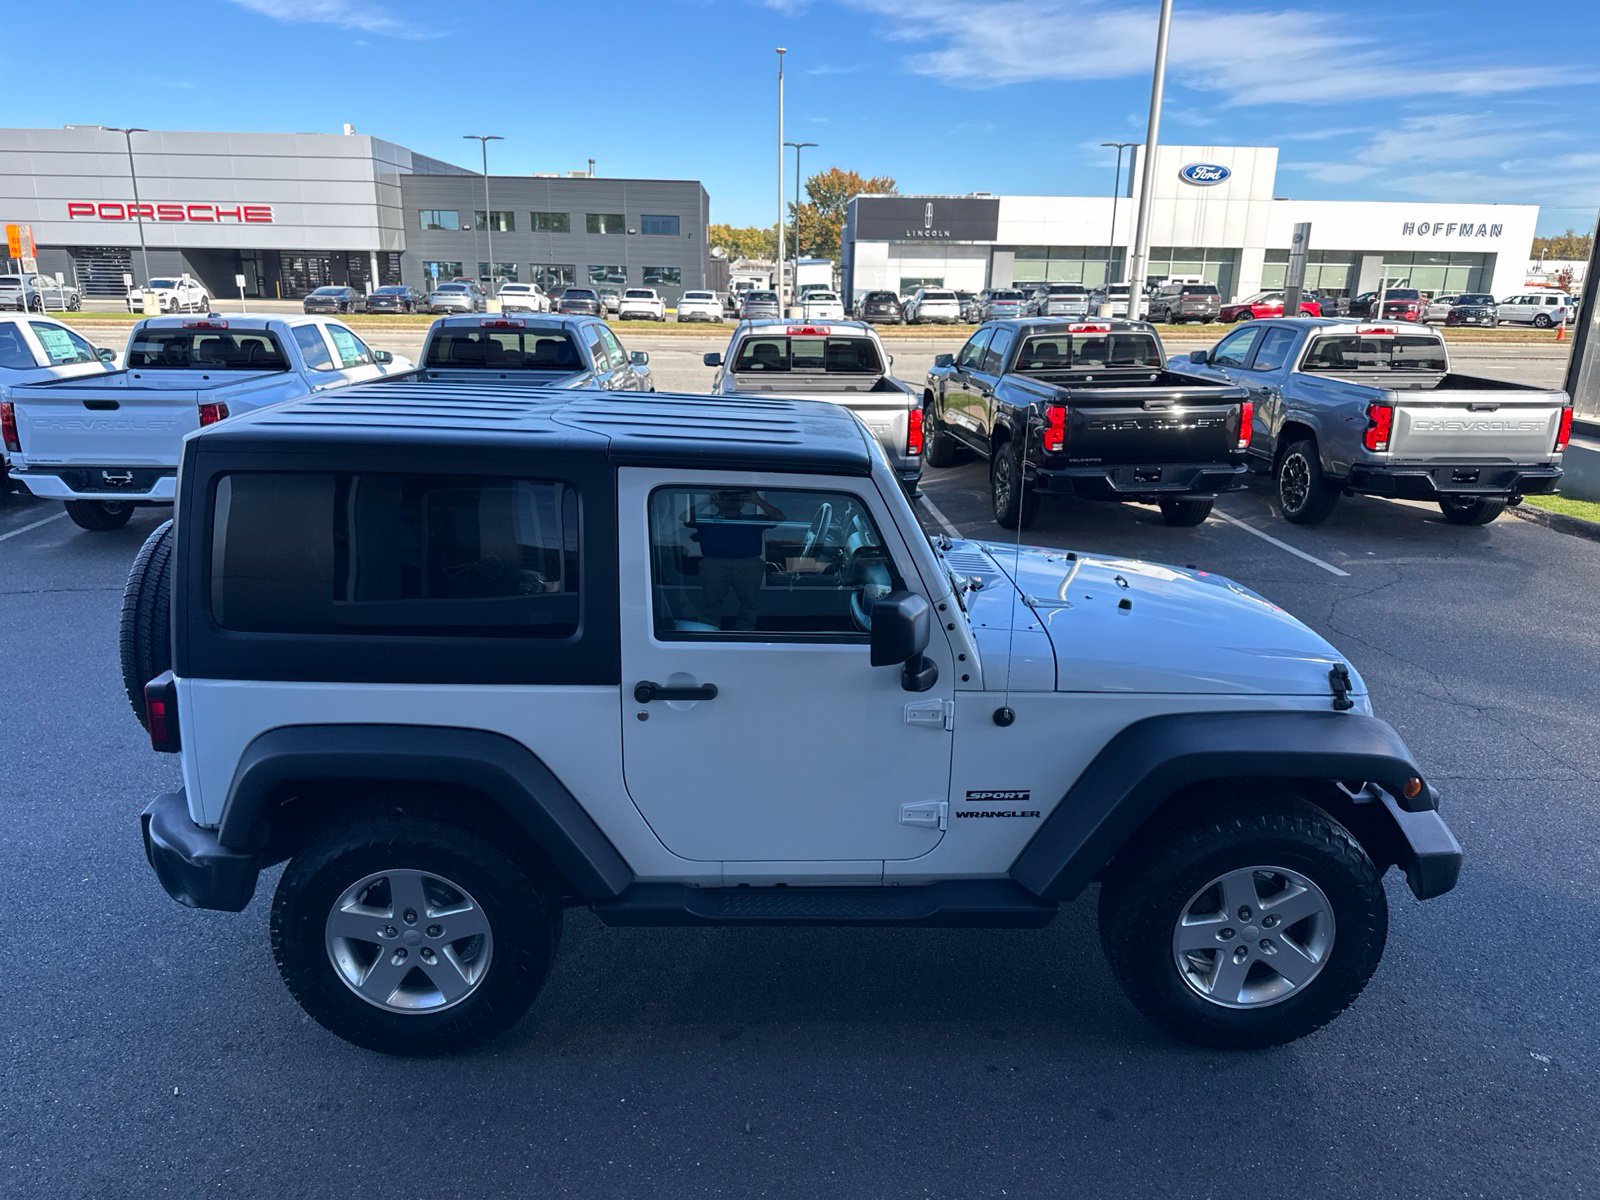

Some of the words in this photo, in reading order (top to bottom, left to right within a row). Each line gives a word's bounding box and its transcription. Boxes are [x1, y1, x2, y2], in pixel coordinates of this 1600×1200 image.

[1192, 165, 1223, 180] Ford
[67, 202, 274, 223] PORSCHE
[905, 229, 951, 238] LINCOLN
[1402, 221, 1503, 238] HOFFMAN
[32, 418, 179, 431] CHEVROLET
[1412, 420, 1546, 431] CHEVROLET
[968, 792, 1030, 800] SPORT
[955, 810, 1041, 818] WRANGLER
